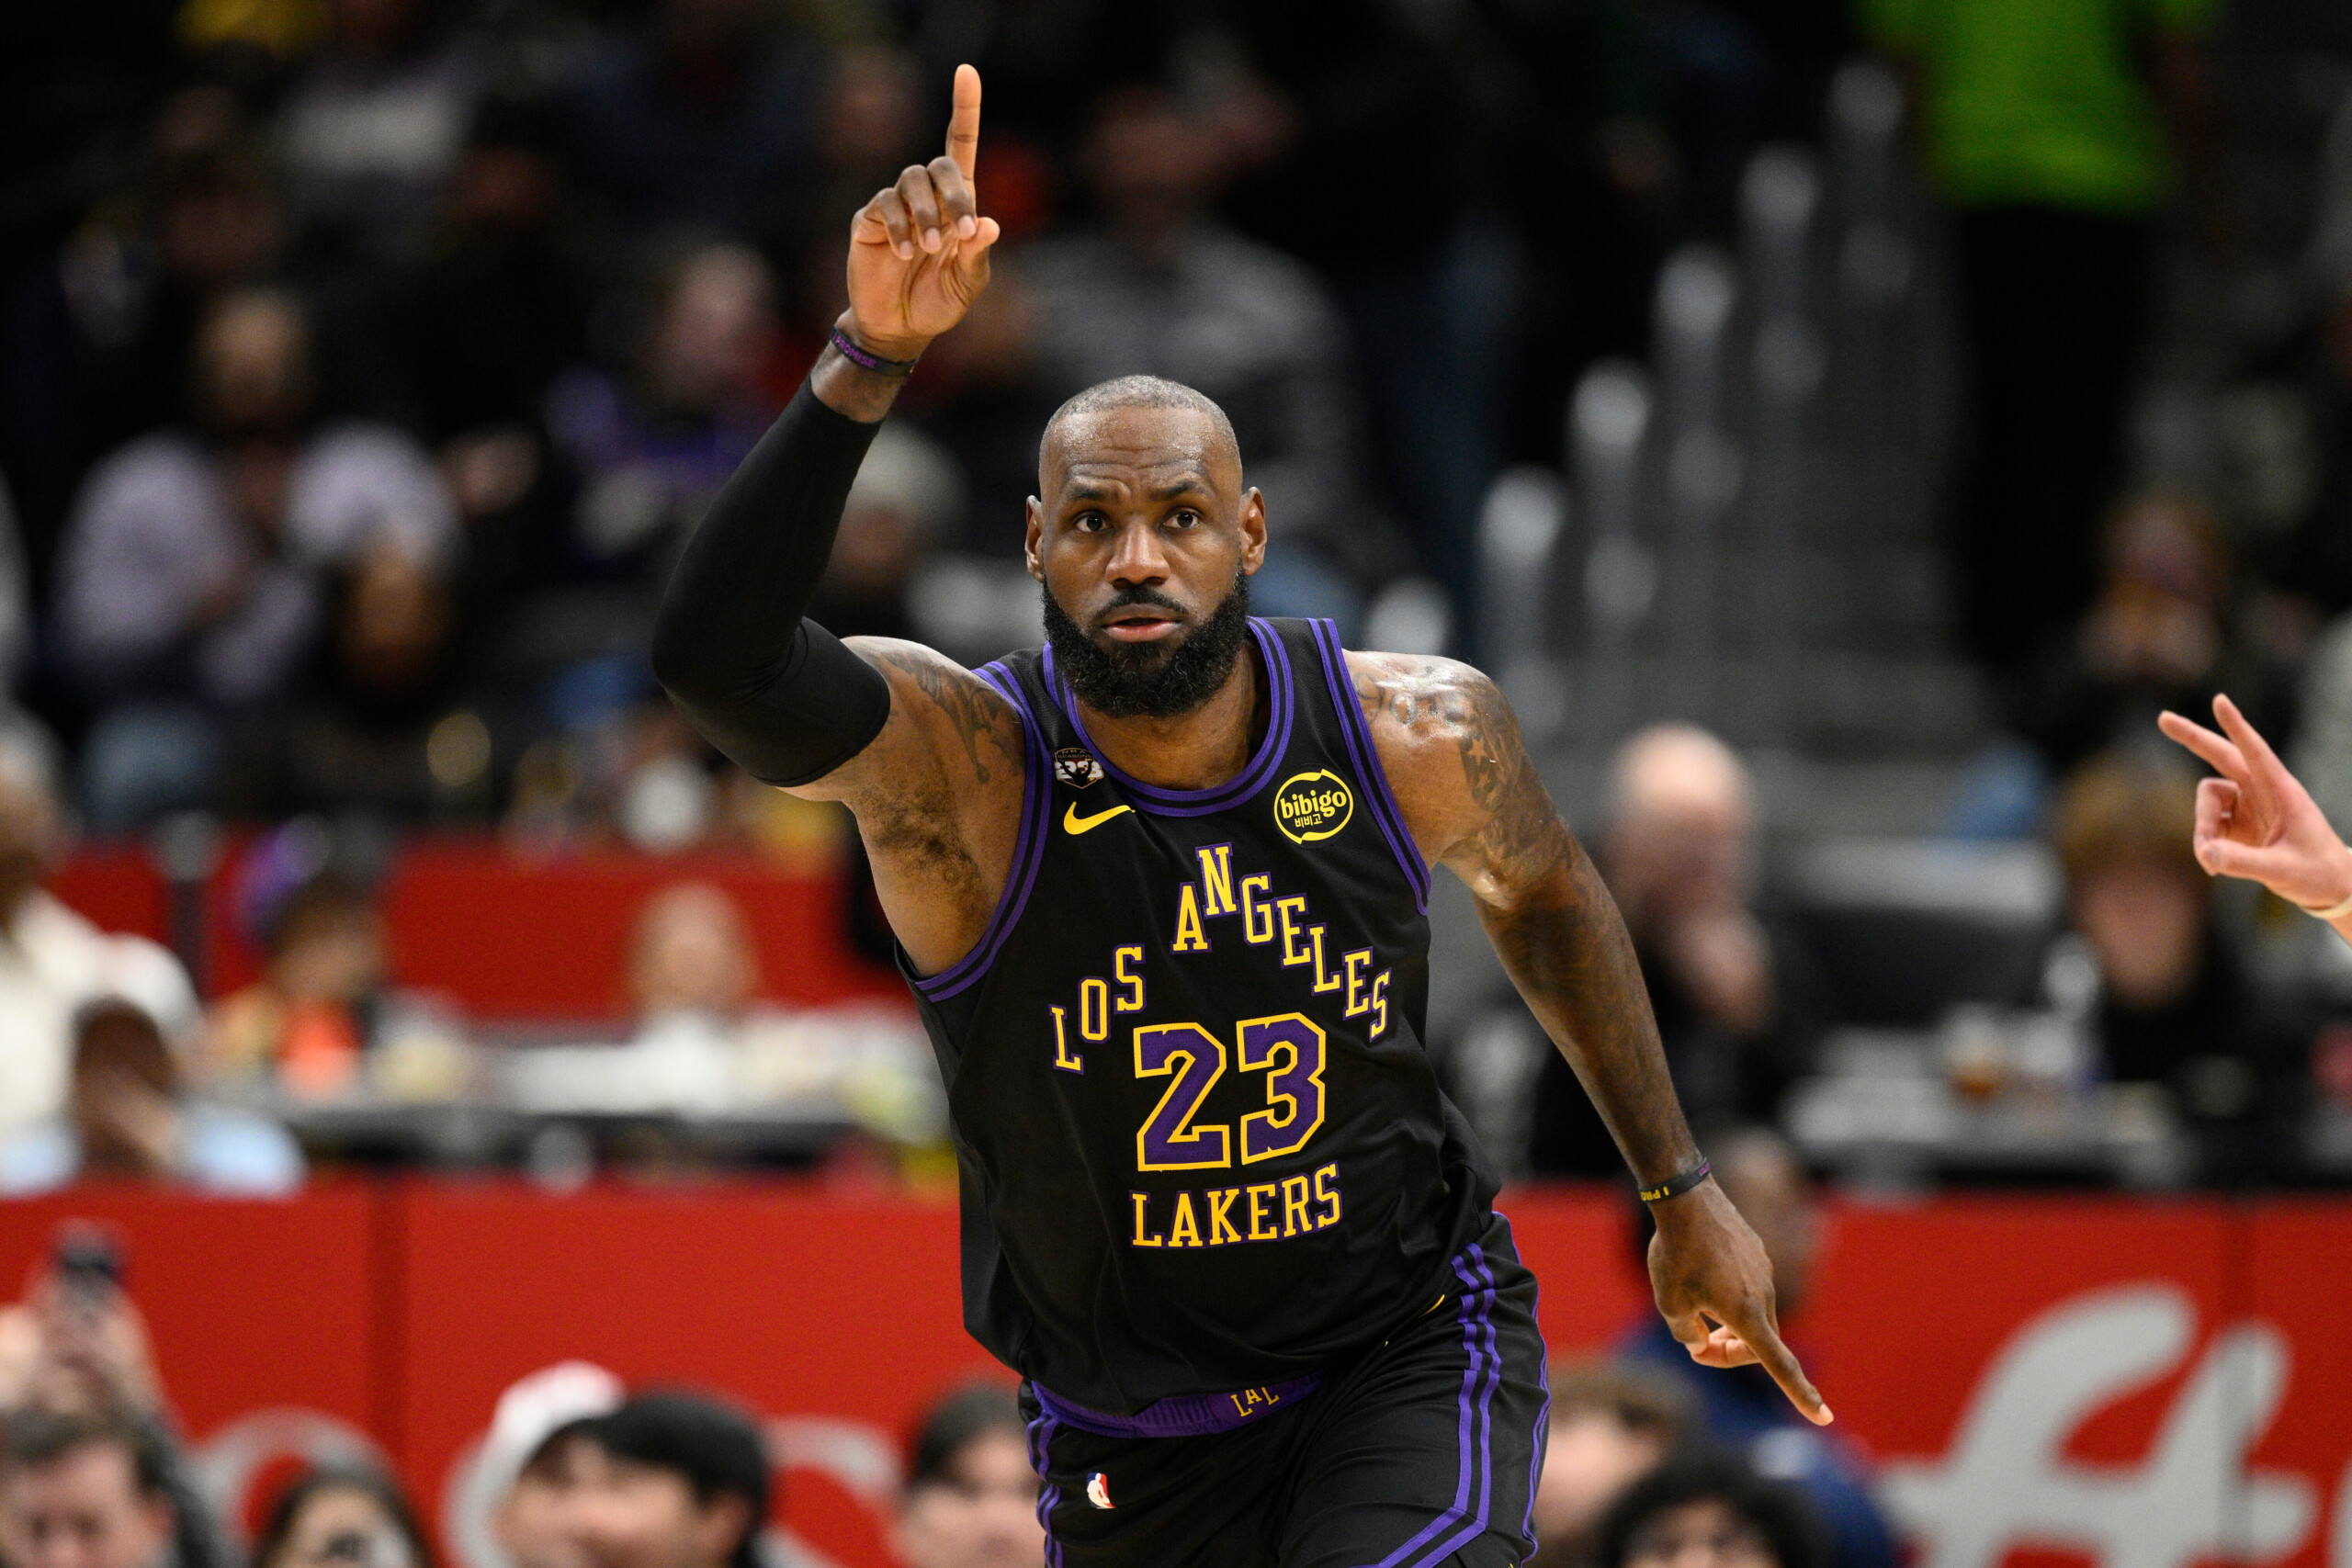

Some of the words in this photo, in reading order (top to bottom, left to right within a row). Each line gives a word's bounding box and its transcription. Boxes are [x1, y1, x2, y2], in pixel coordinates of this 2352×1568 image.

[835, 335, 876, 368] PROMISE
[1280, 789, 1347, 819] bibigo
[1294, 813, 1323, 829] 비비고
[1050, 944, 1145, 1073] LOS
[1171, 841, 1392, 1042] ANGELES
[1133, 1012, 1326, 1172] 23
[1132, 1162, 1341, 1247] LAKERS
[1230, 1387, 1280, 1416] LAL
